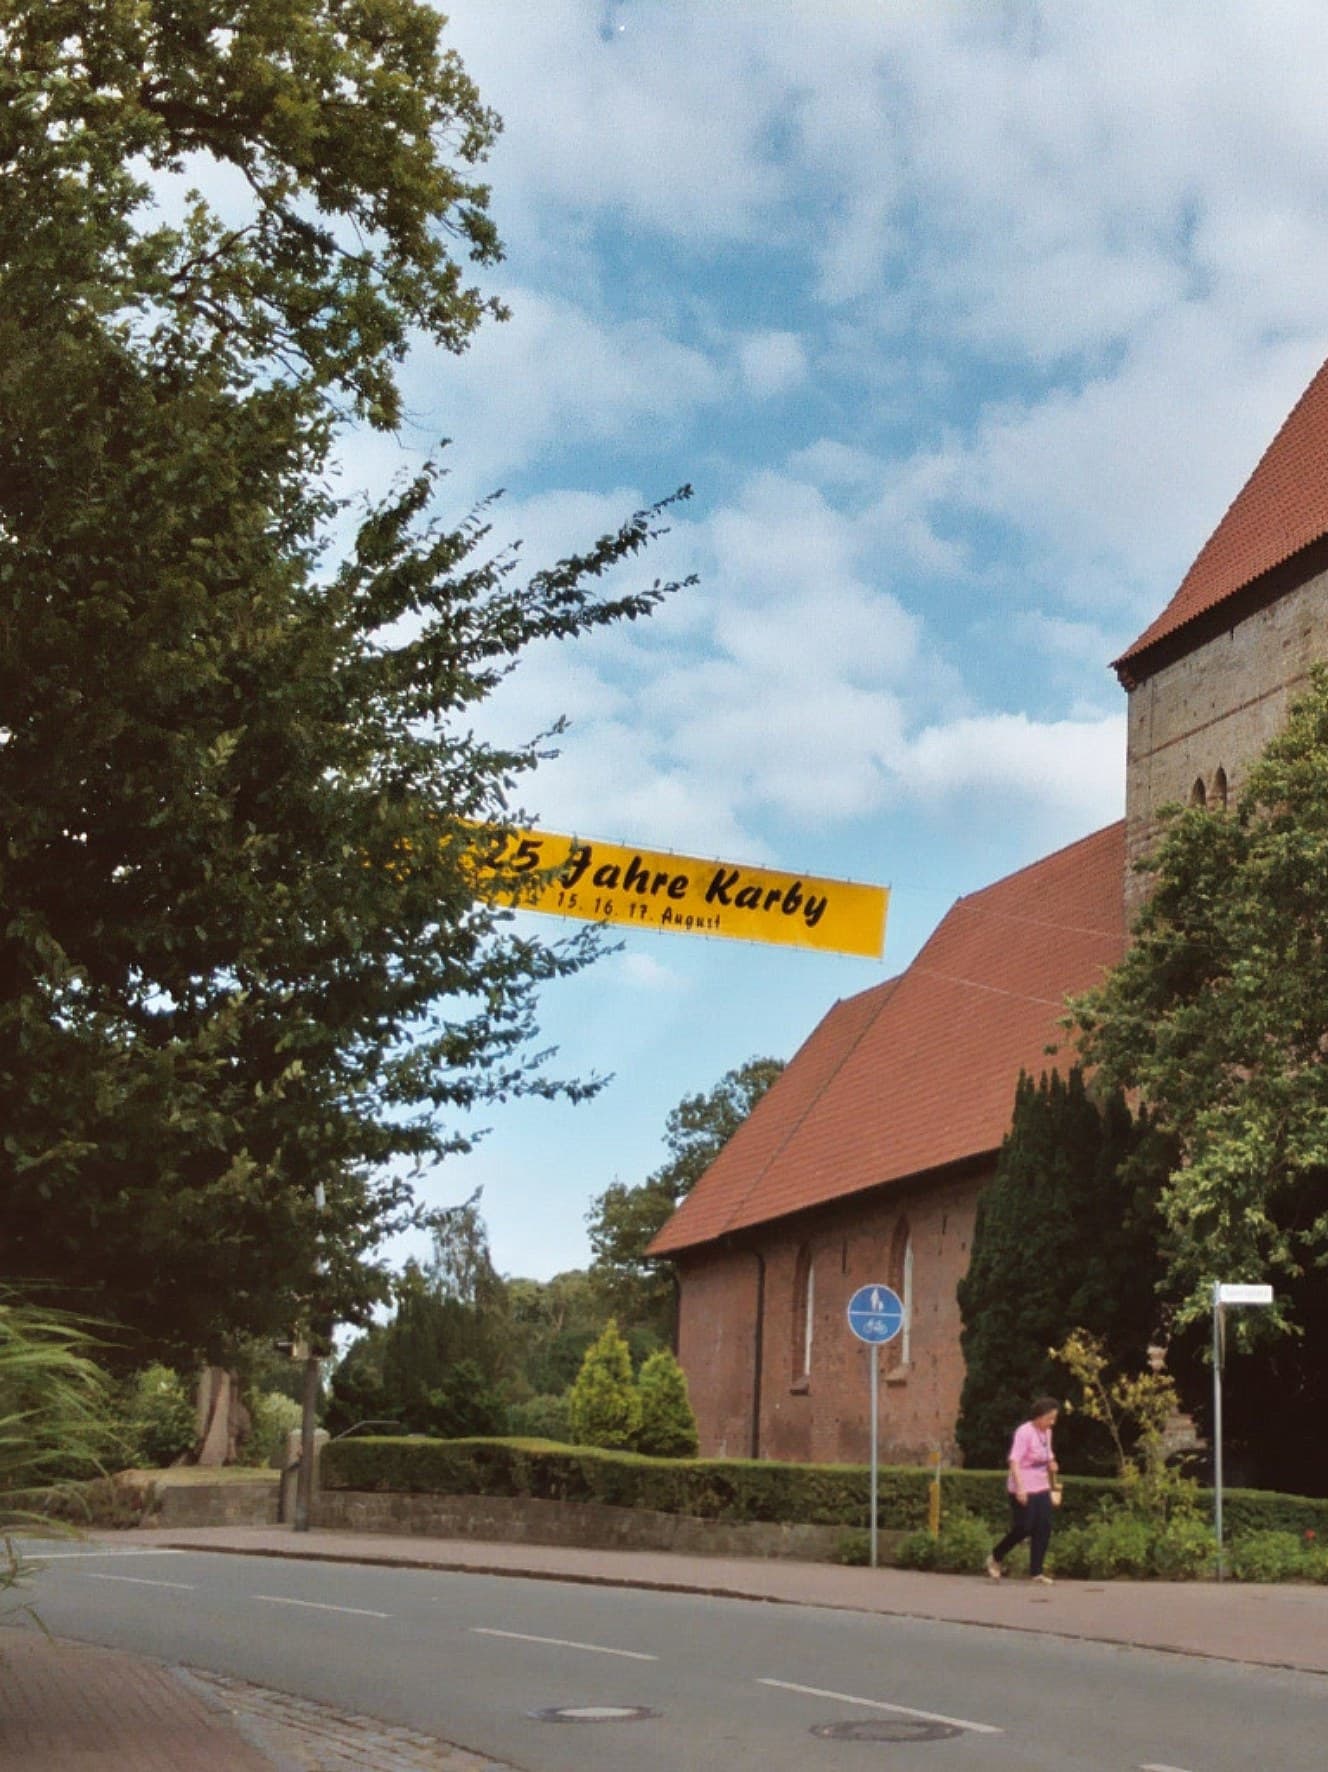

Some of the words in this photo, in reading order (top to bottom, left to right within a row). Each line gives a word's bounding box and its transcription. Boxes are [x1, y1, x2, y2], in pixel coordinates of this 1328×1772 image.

[560, 845, 689, 899] Jahre
[705, 868, 828, 928] Karby
[661, 906, 721, 930] August
